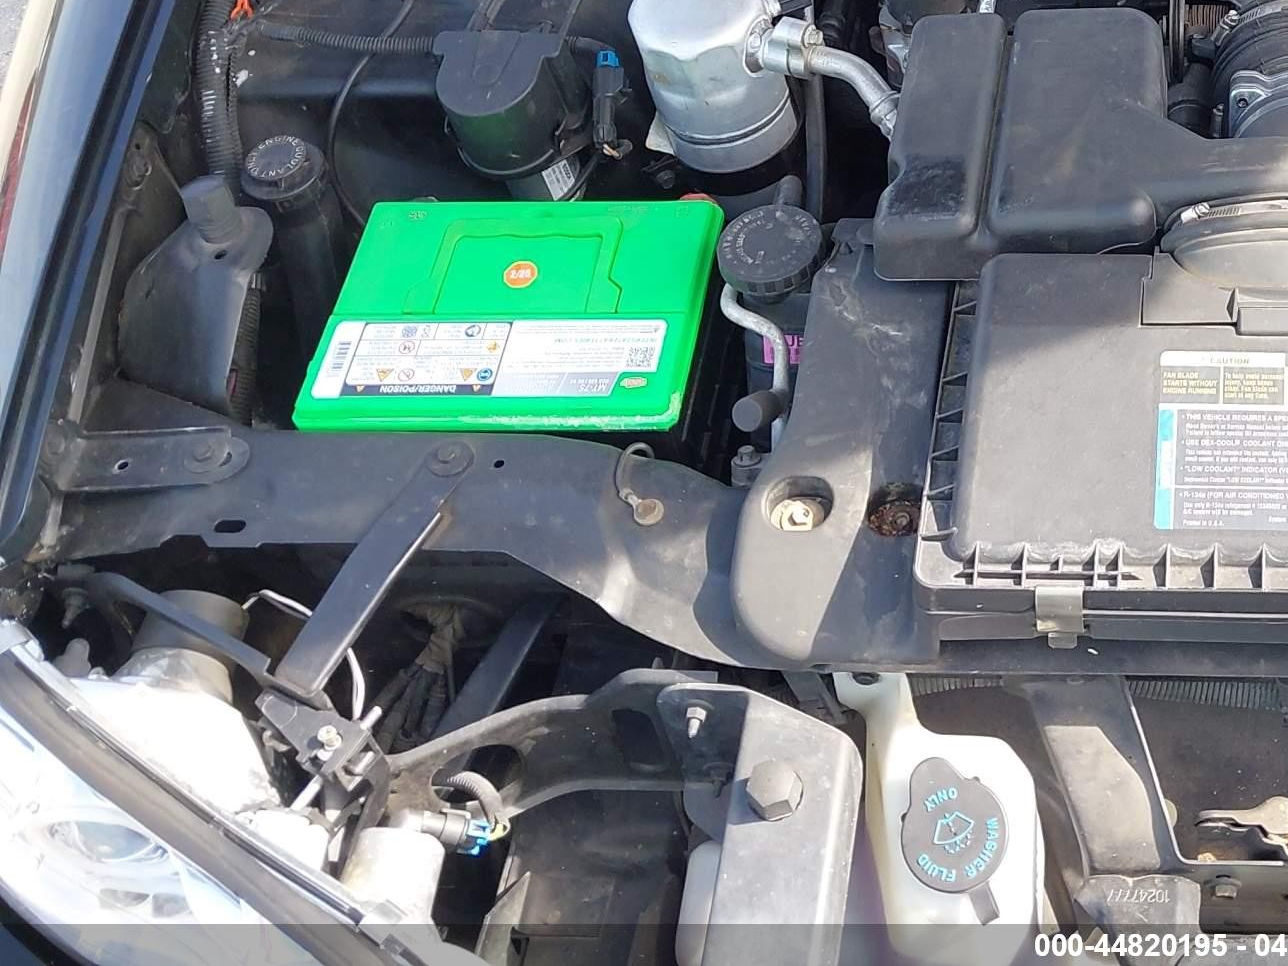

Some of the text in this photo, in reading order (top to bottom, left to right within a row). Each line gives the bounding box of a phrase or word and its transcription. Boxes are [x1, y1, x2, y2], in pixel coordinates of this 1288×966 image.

[258, 134, 299, 150] ENGINE
[261, 146, 305, 178] COOLANT
[1210, 356, 1250, 364] CAUTION
[1163, 371, 1199, 379] FAN BLADE
[1163, 379, 1218, 387] STARTS WITHOUT
[379, 384, 457, 394] DANGER/POISON
[1162, 387, 1217, 395] ENGINE RUNNING
[1186, 413, 1201, 421] THIS
[1232, 414, 1266, 422] REQUIRES
[1186, 439, 1200, 447] USE
[1242, 440, 1275, 448] COOLANT
[1184, 465, 1204, 473] "LOW
[1205, 466, 1240, 474] COOLANT"
[1241, 466, 1277, 474] INDICATOR
[1207, 491, 1224, 500] (FOR
[1225, 491, 1239, 499] AIR
[1239, 492, 1285, 500] CONDITIONED
[916, 787, 1000, 883] WASHER FLUID ONLY
